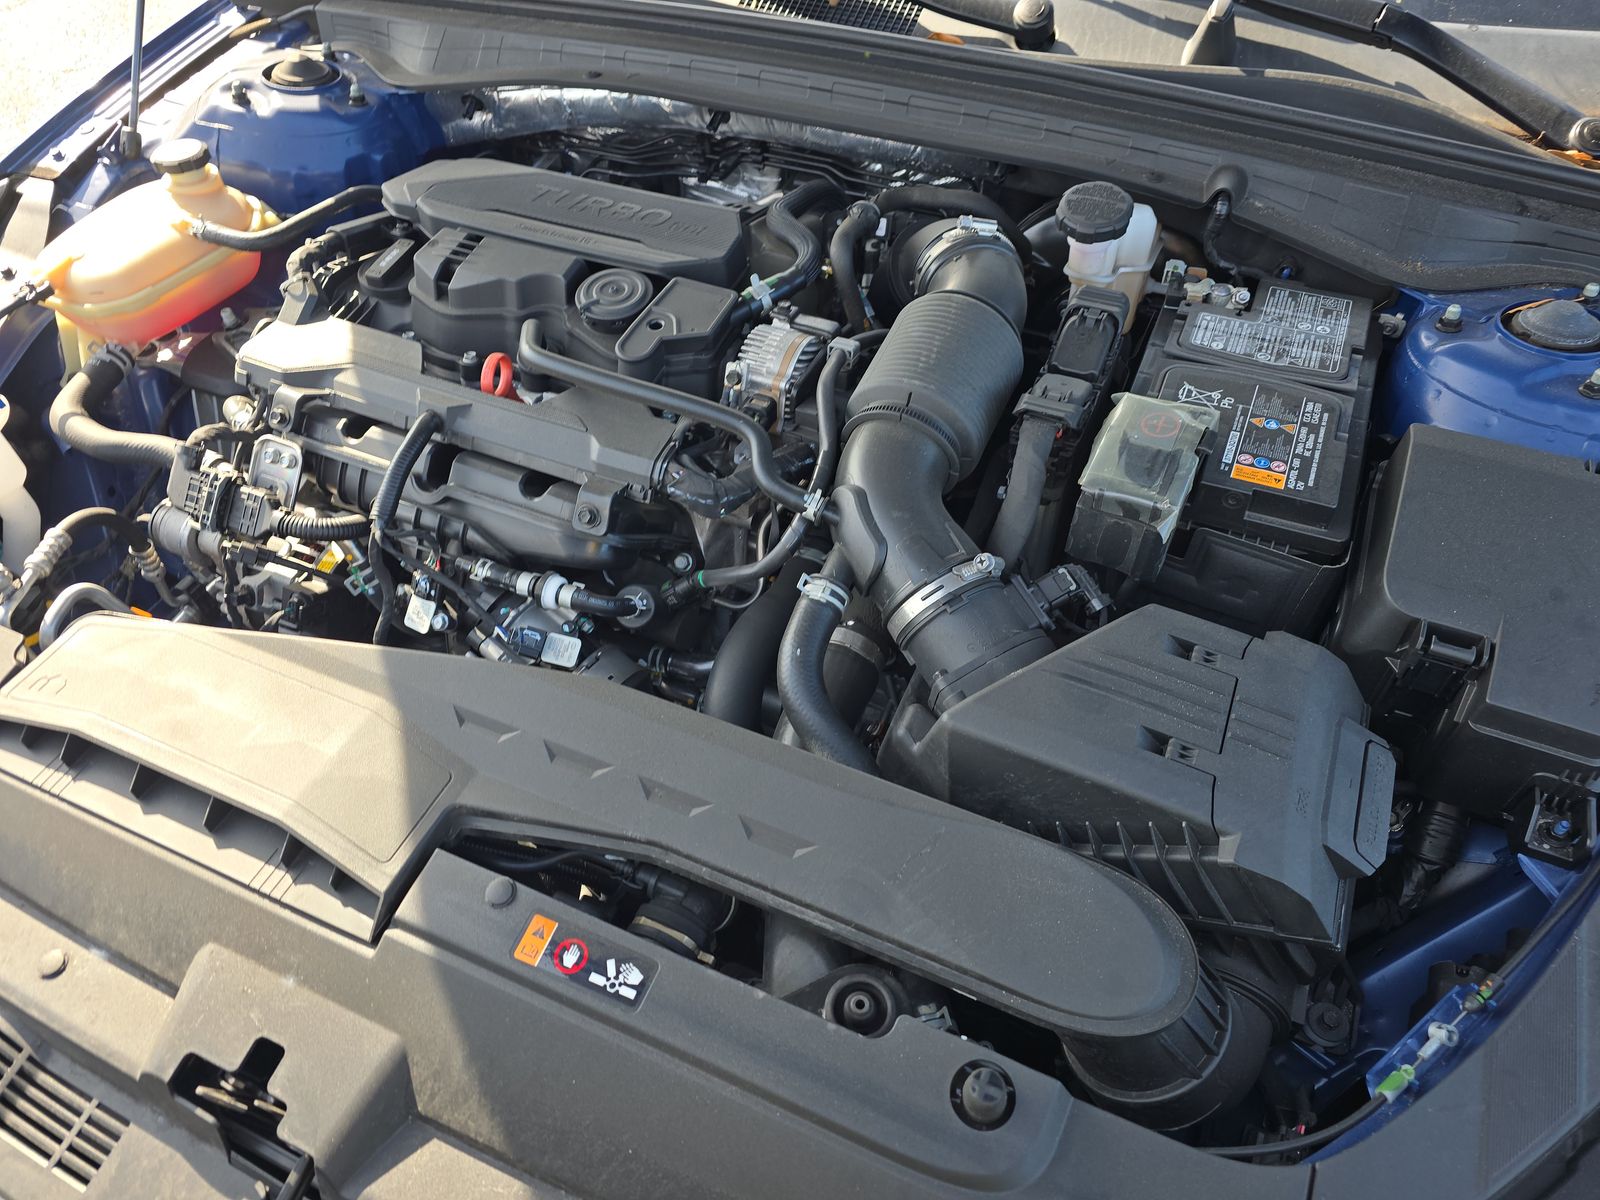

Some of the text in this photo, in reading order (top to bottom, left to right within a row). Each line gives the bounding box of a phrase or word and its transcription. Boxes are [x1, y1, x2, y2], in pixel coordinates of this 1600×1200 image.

[531, 183, 672, 227] TURBO
[1220, 397, 1234, 409] Pb
[1296, 480, 1304, 490] 12V
